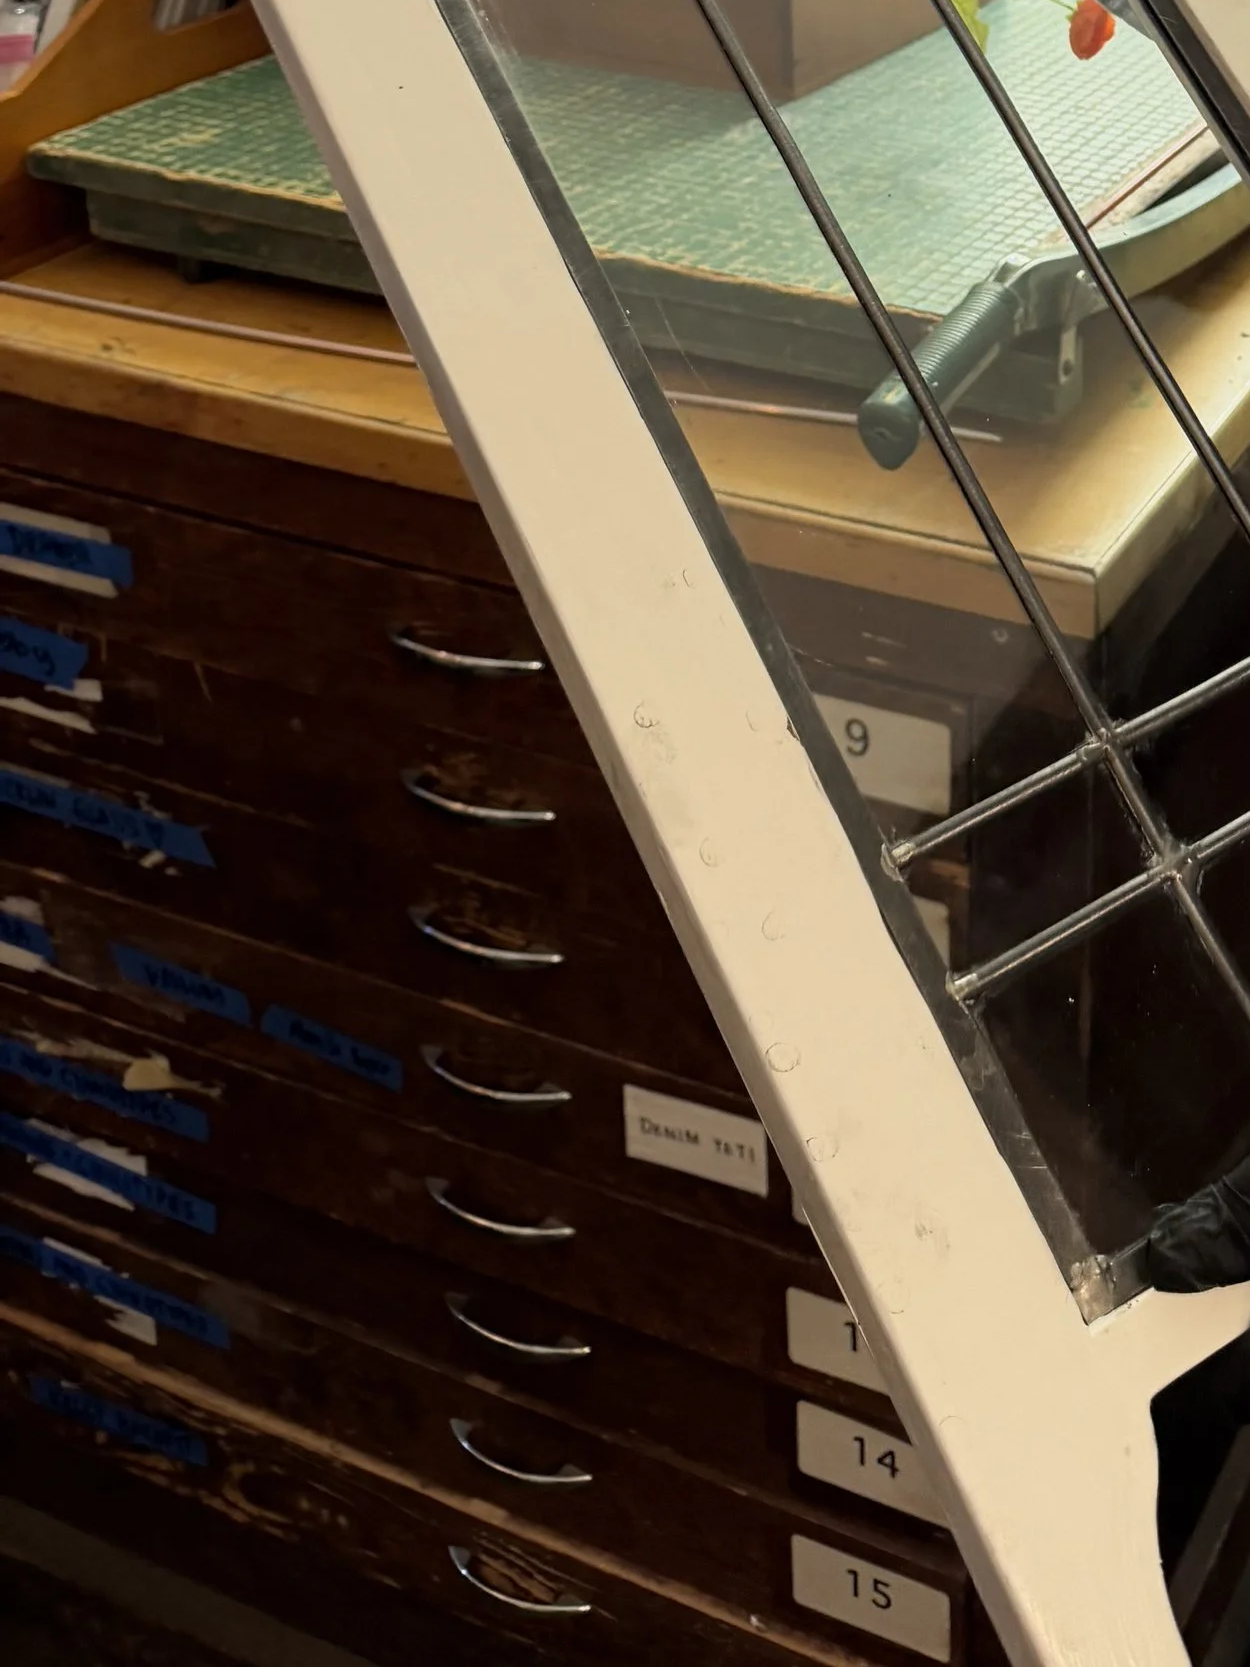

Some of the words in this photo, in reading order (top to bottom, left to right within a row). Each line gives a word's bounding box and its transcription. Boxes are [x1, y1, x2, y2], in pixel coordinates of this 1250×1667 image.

[845, 717, 870, 757] 9
[851, 1436, 900, 1480] 14
[845, 1568, 893, 1610] 15
